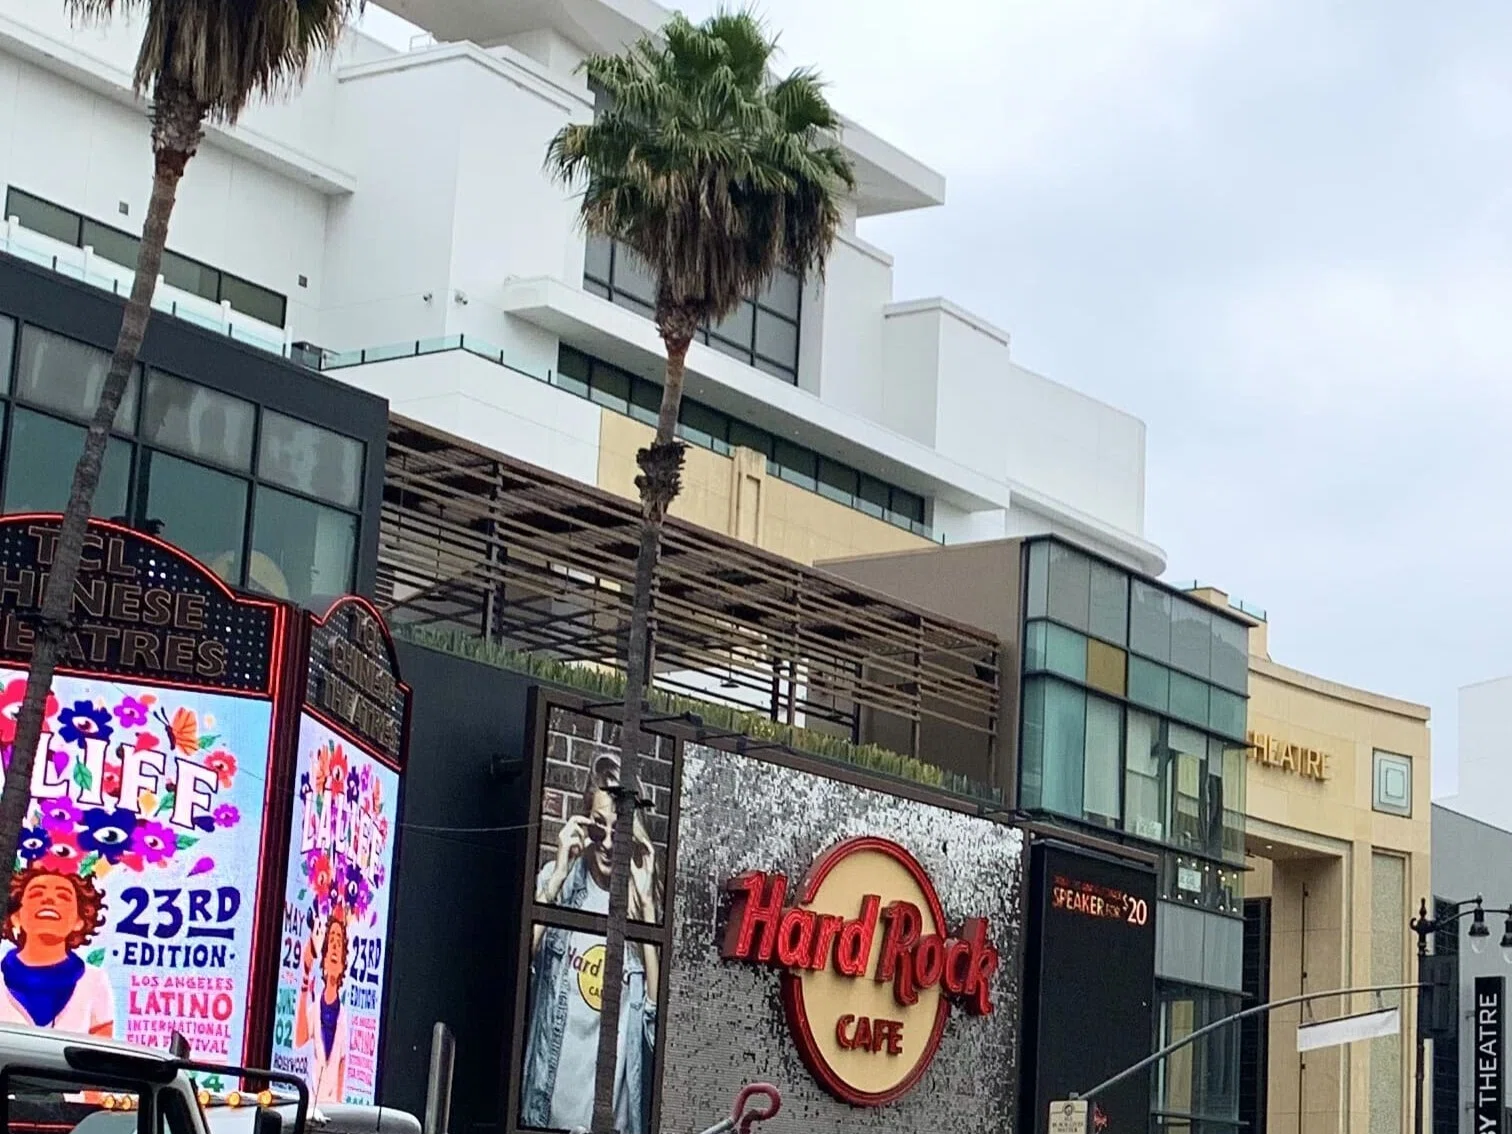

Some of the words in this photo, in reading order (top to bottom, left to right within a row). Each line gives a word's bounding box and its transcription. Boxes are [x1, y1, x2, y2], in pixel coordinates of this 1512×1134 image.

[1250, 731, 1330, 780] HEATRE
[116, 886, 241, 939] 23RD
[284, 901, 305, 937] MAY
[1053, 887, 1105, 917] SPEAKER
[1122, 894, 1148, 925] $20
[123, 942, 227, 968] EDITION
[283, 937, 301, 969] 29
[350, 936, 381, 984] 23RD
[721, 870, 881, 977] Hard
[874, 900, 998, 1016] Rock
[131, 975, 159, 987] LOS
[164, 977, 233, 990] ANGELES
[129, 990, 233, 1021] LATINO
[127, 1019, 231, 1038] INTERNATIONAL
[836, 1013, 904, 1055] CAFE
[1479, 993, 1498, 1105] THEATRE
